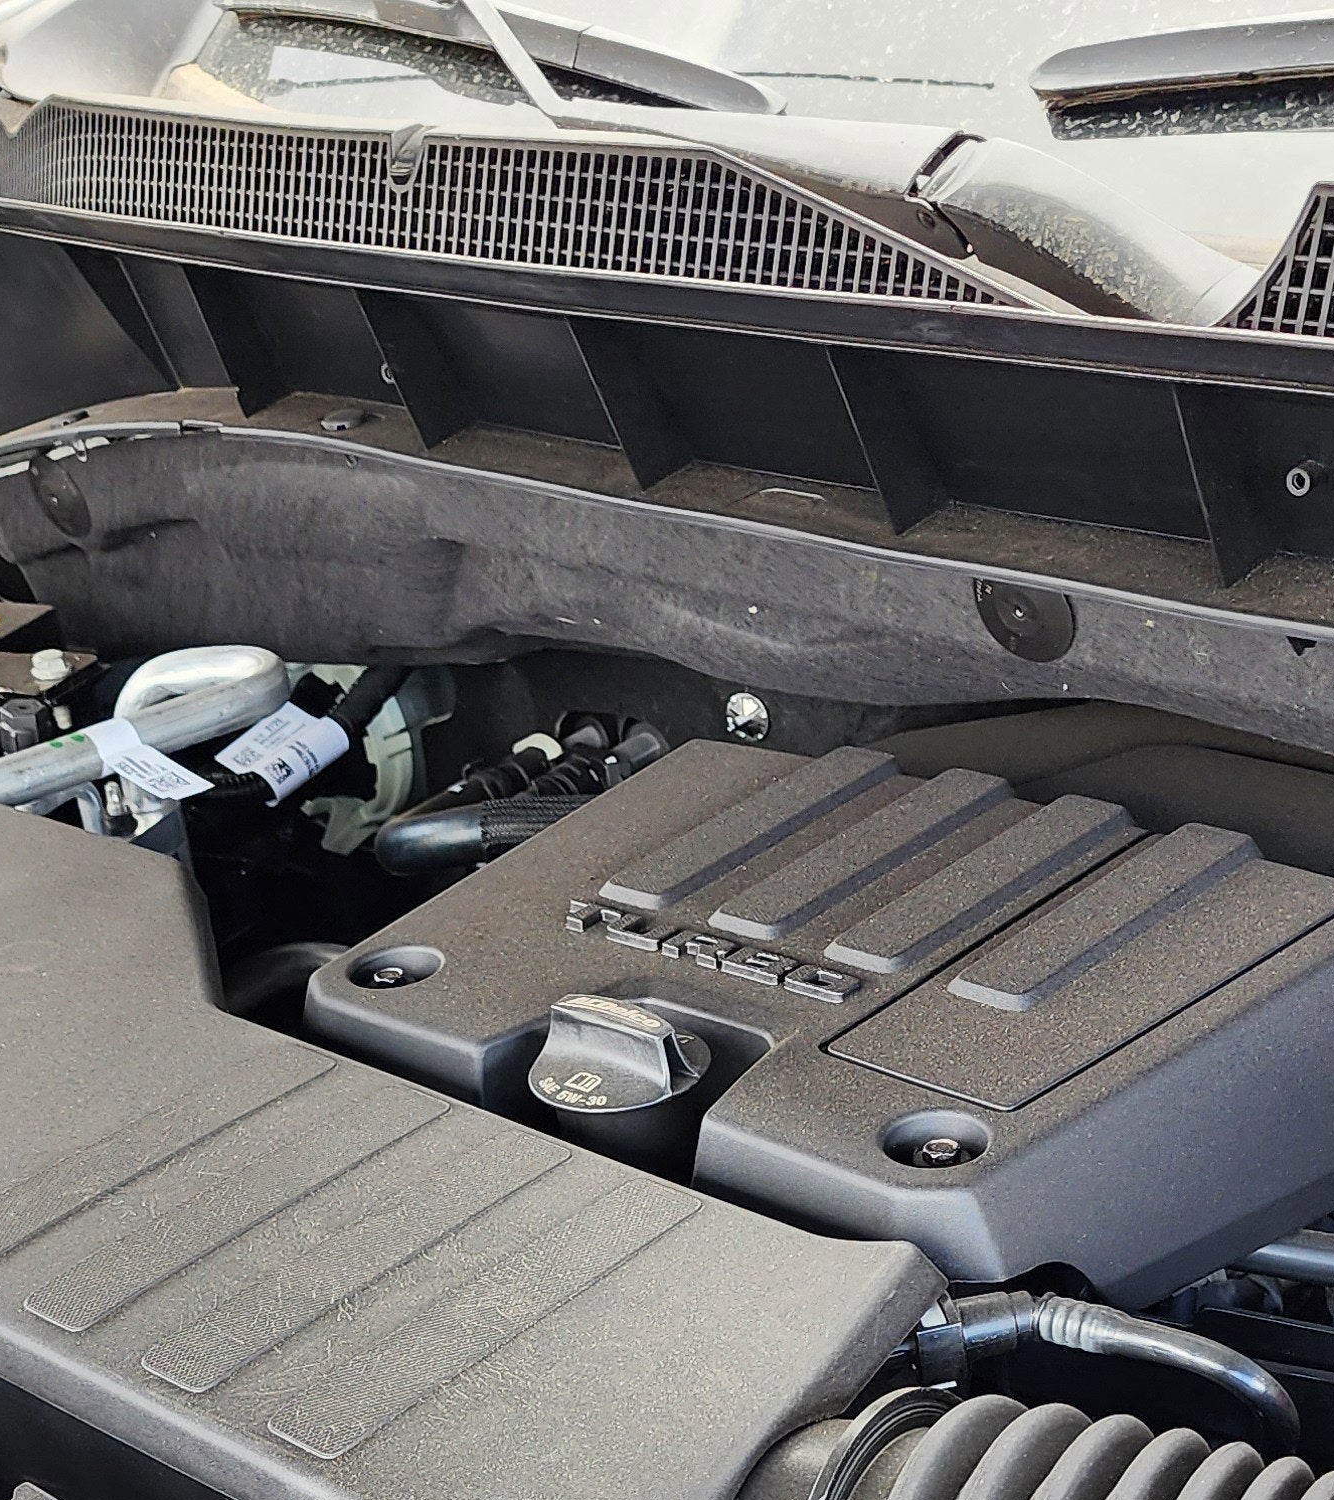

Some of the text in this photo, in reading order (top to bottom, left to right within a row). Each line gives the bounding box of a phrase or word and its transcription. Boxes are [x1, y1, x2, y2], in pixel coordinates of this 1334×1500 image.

[565, 899, 861, 1004] TURBO
[558, 996, 662, 1029] ACDelco
[556, 1090, 607, 1107] 5W-30
